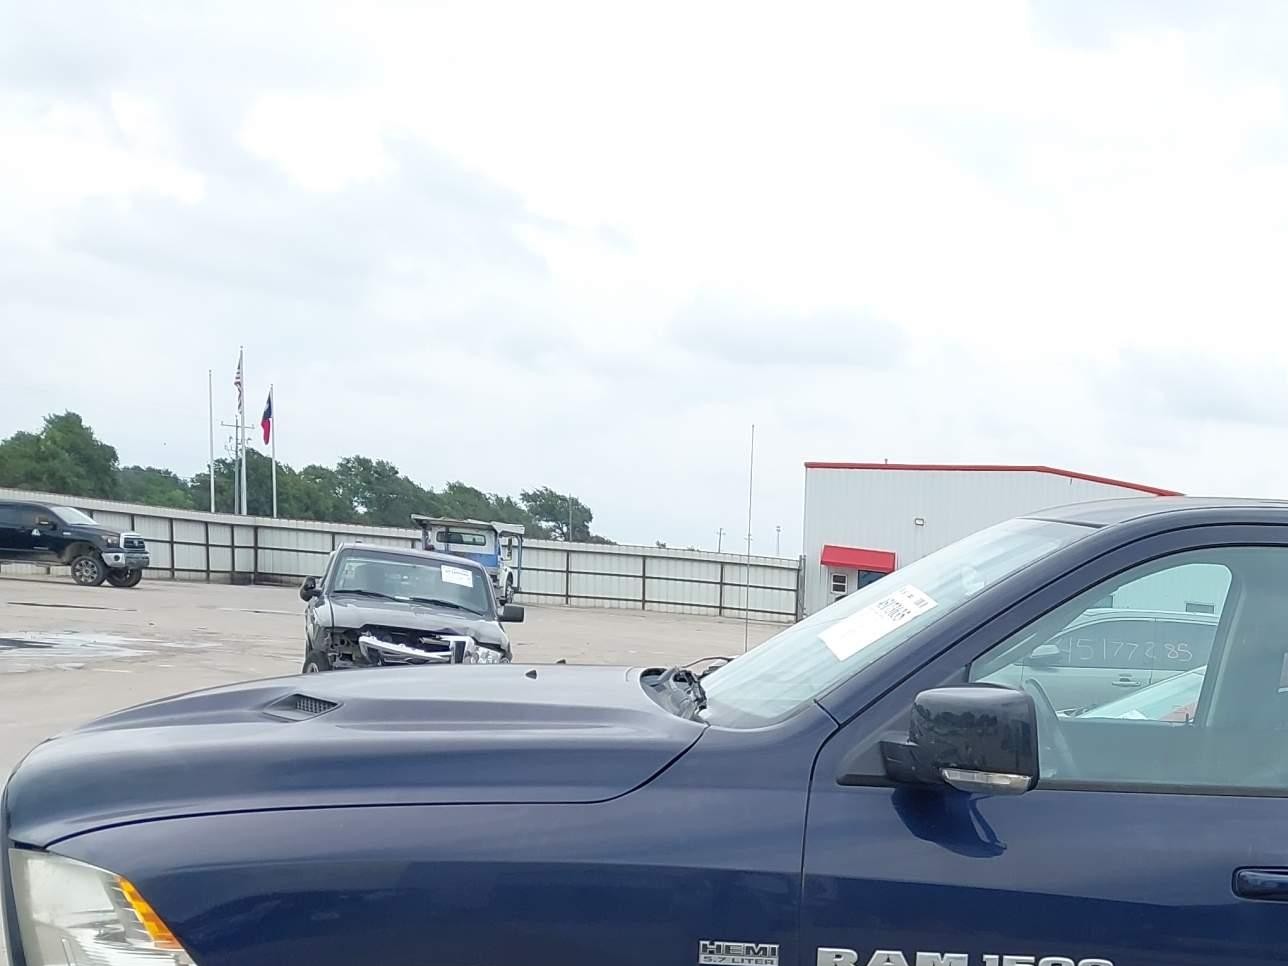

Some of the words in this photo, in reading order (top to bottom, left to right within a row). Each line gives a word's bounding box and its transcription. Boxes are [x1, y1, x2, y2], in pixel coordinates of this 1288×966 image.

[700, 941, 779, 958] HEMI
[703, 955, 726, 964] 5.7
[731, 956, 775, 966] LITER
